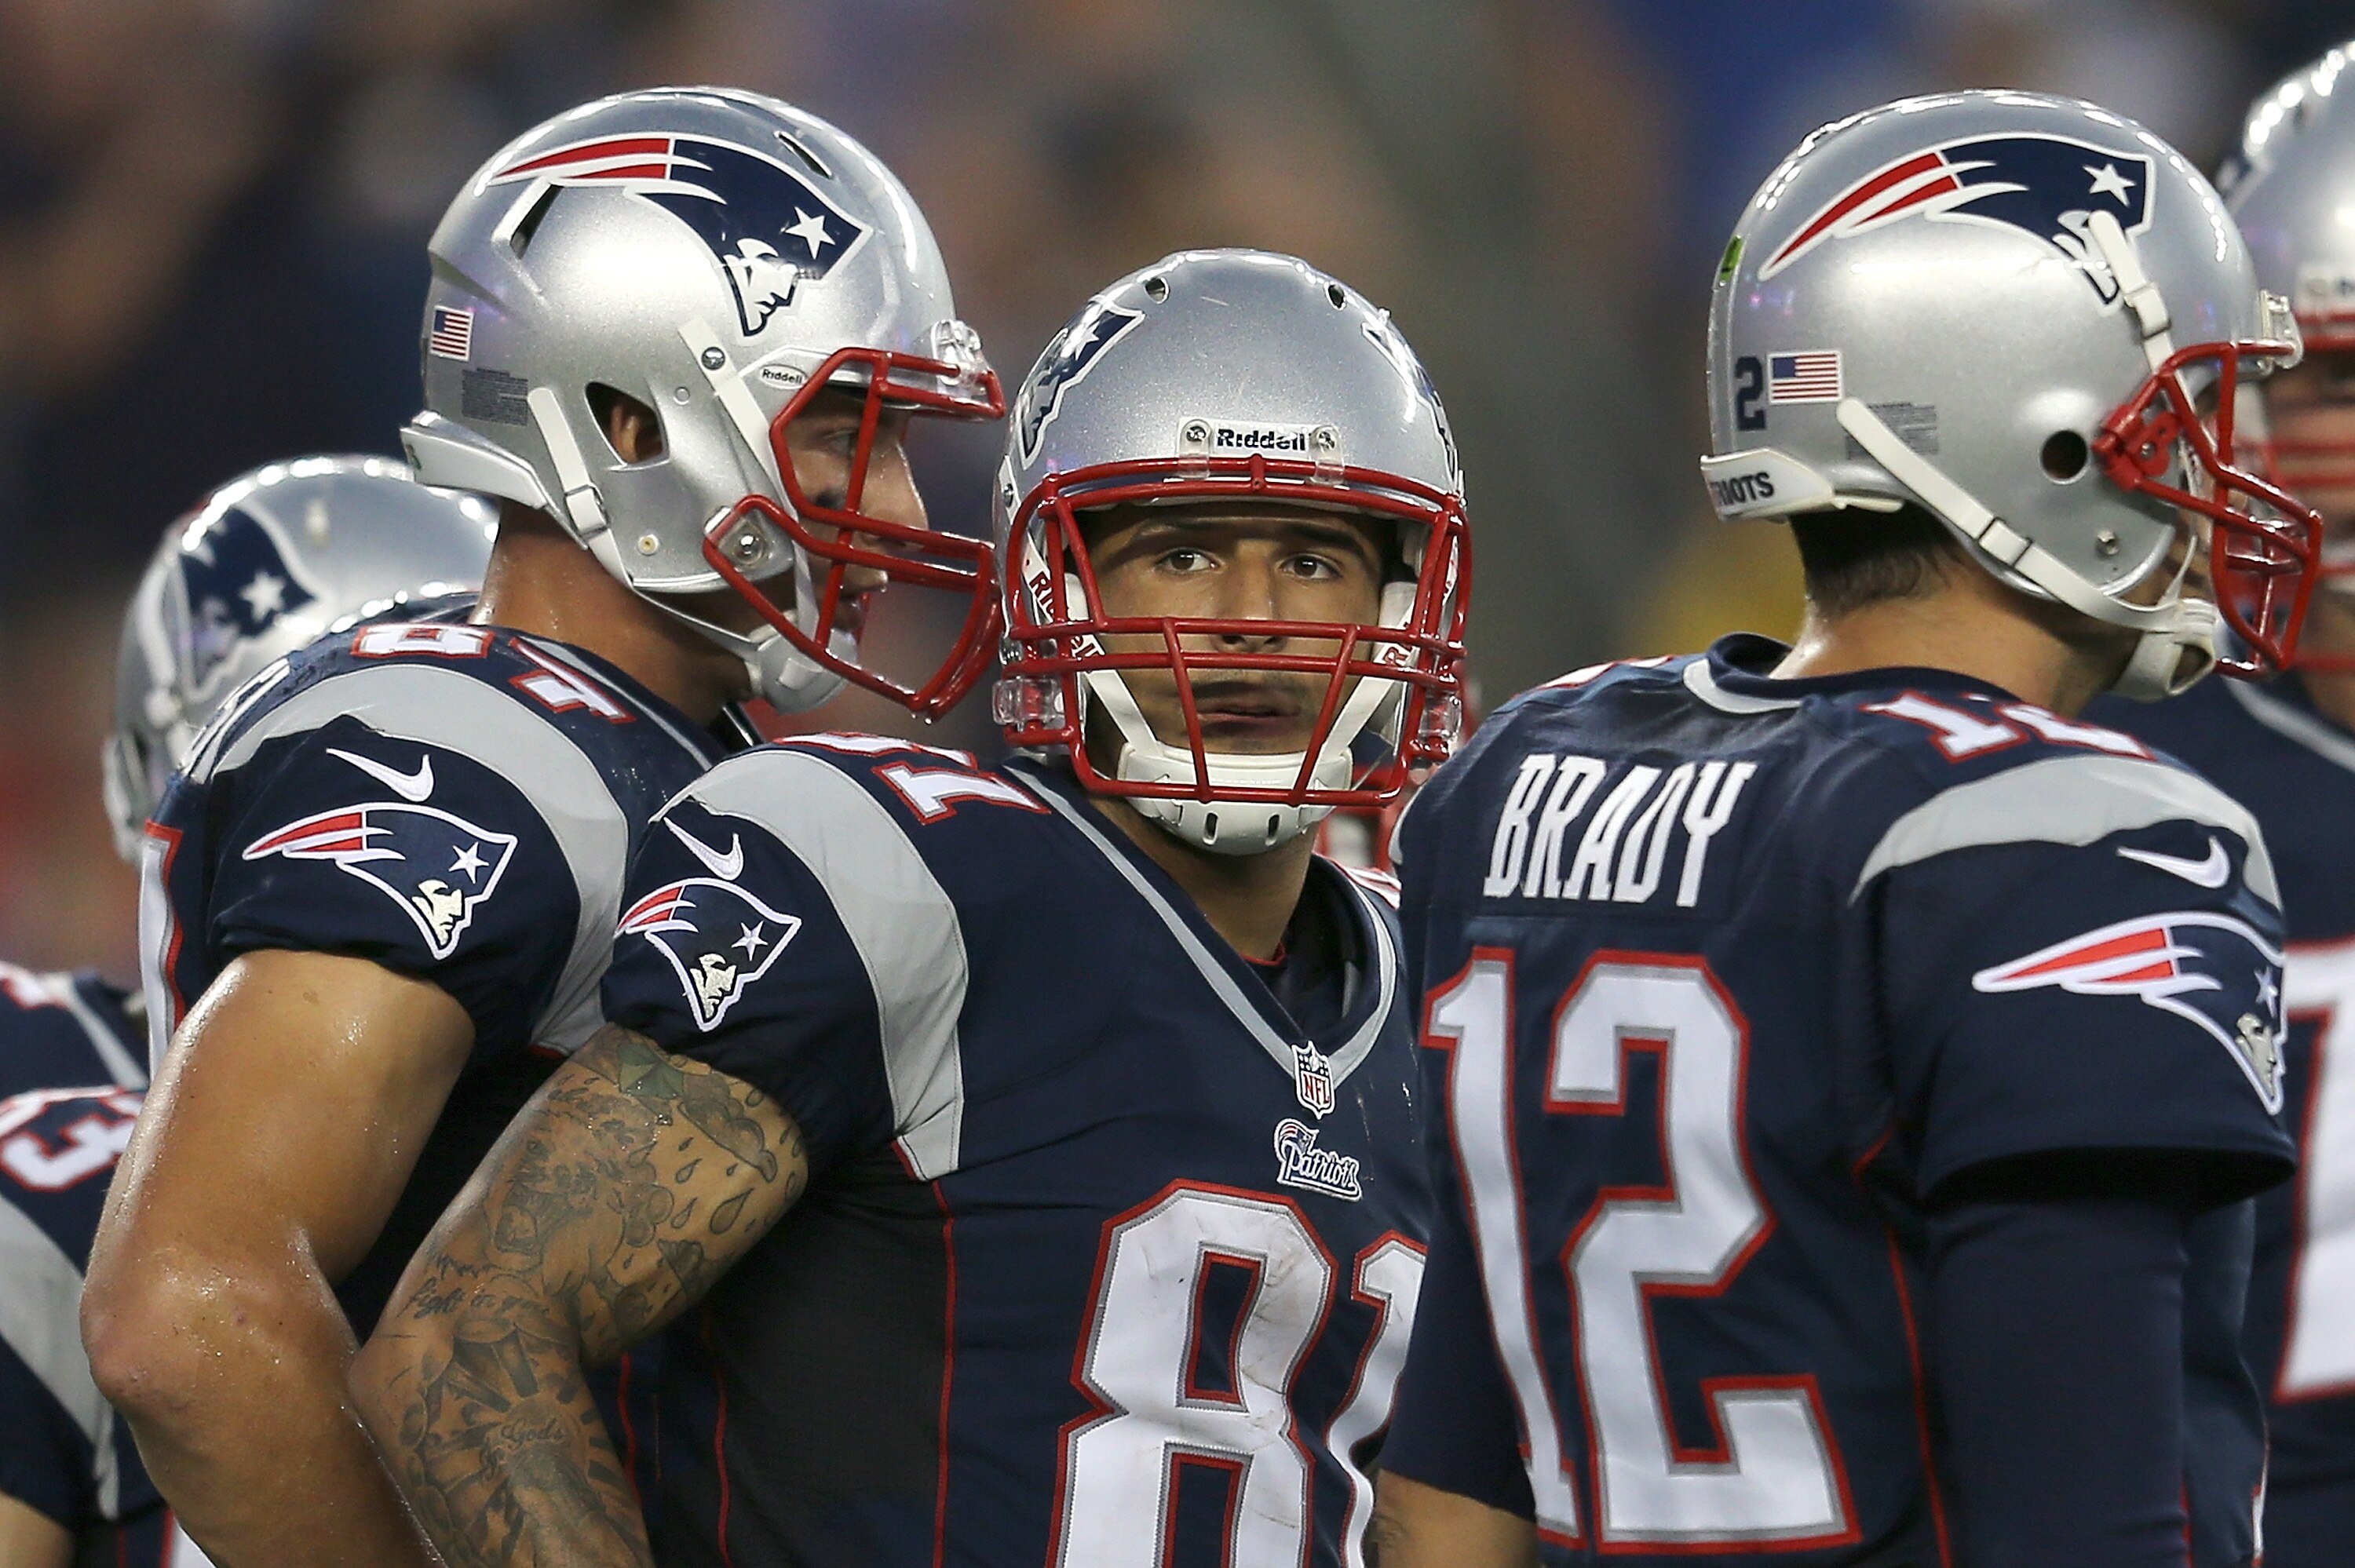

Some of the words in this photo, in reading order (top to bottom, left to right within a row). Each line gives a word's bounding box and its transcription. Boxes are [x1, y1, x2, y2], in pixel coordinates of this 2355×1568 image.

[762, 368, 803, 385] Riddell
[1217, 428, 1312, 451] Riddell
[1482, 753, 1758, 908] BRADY
[1302, 1072, 1331, 1105] NFL
[1281, 1138, 1356, 1190] Patriots
[1418, 945, 1863, 1555] 12
[1045, 1178, 1429, 1568] 81
